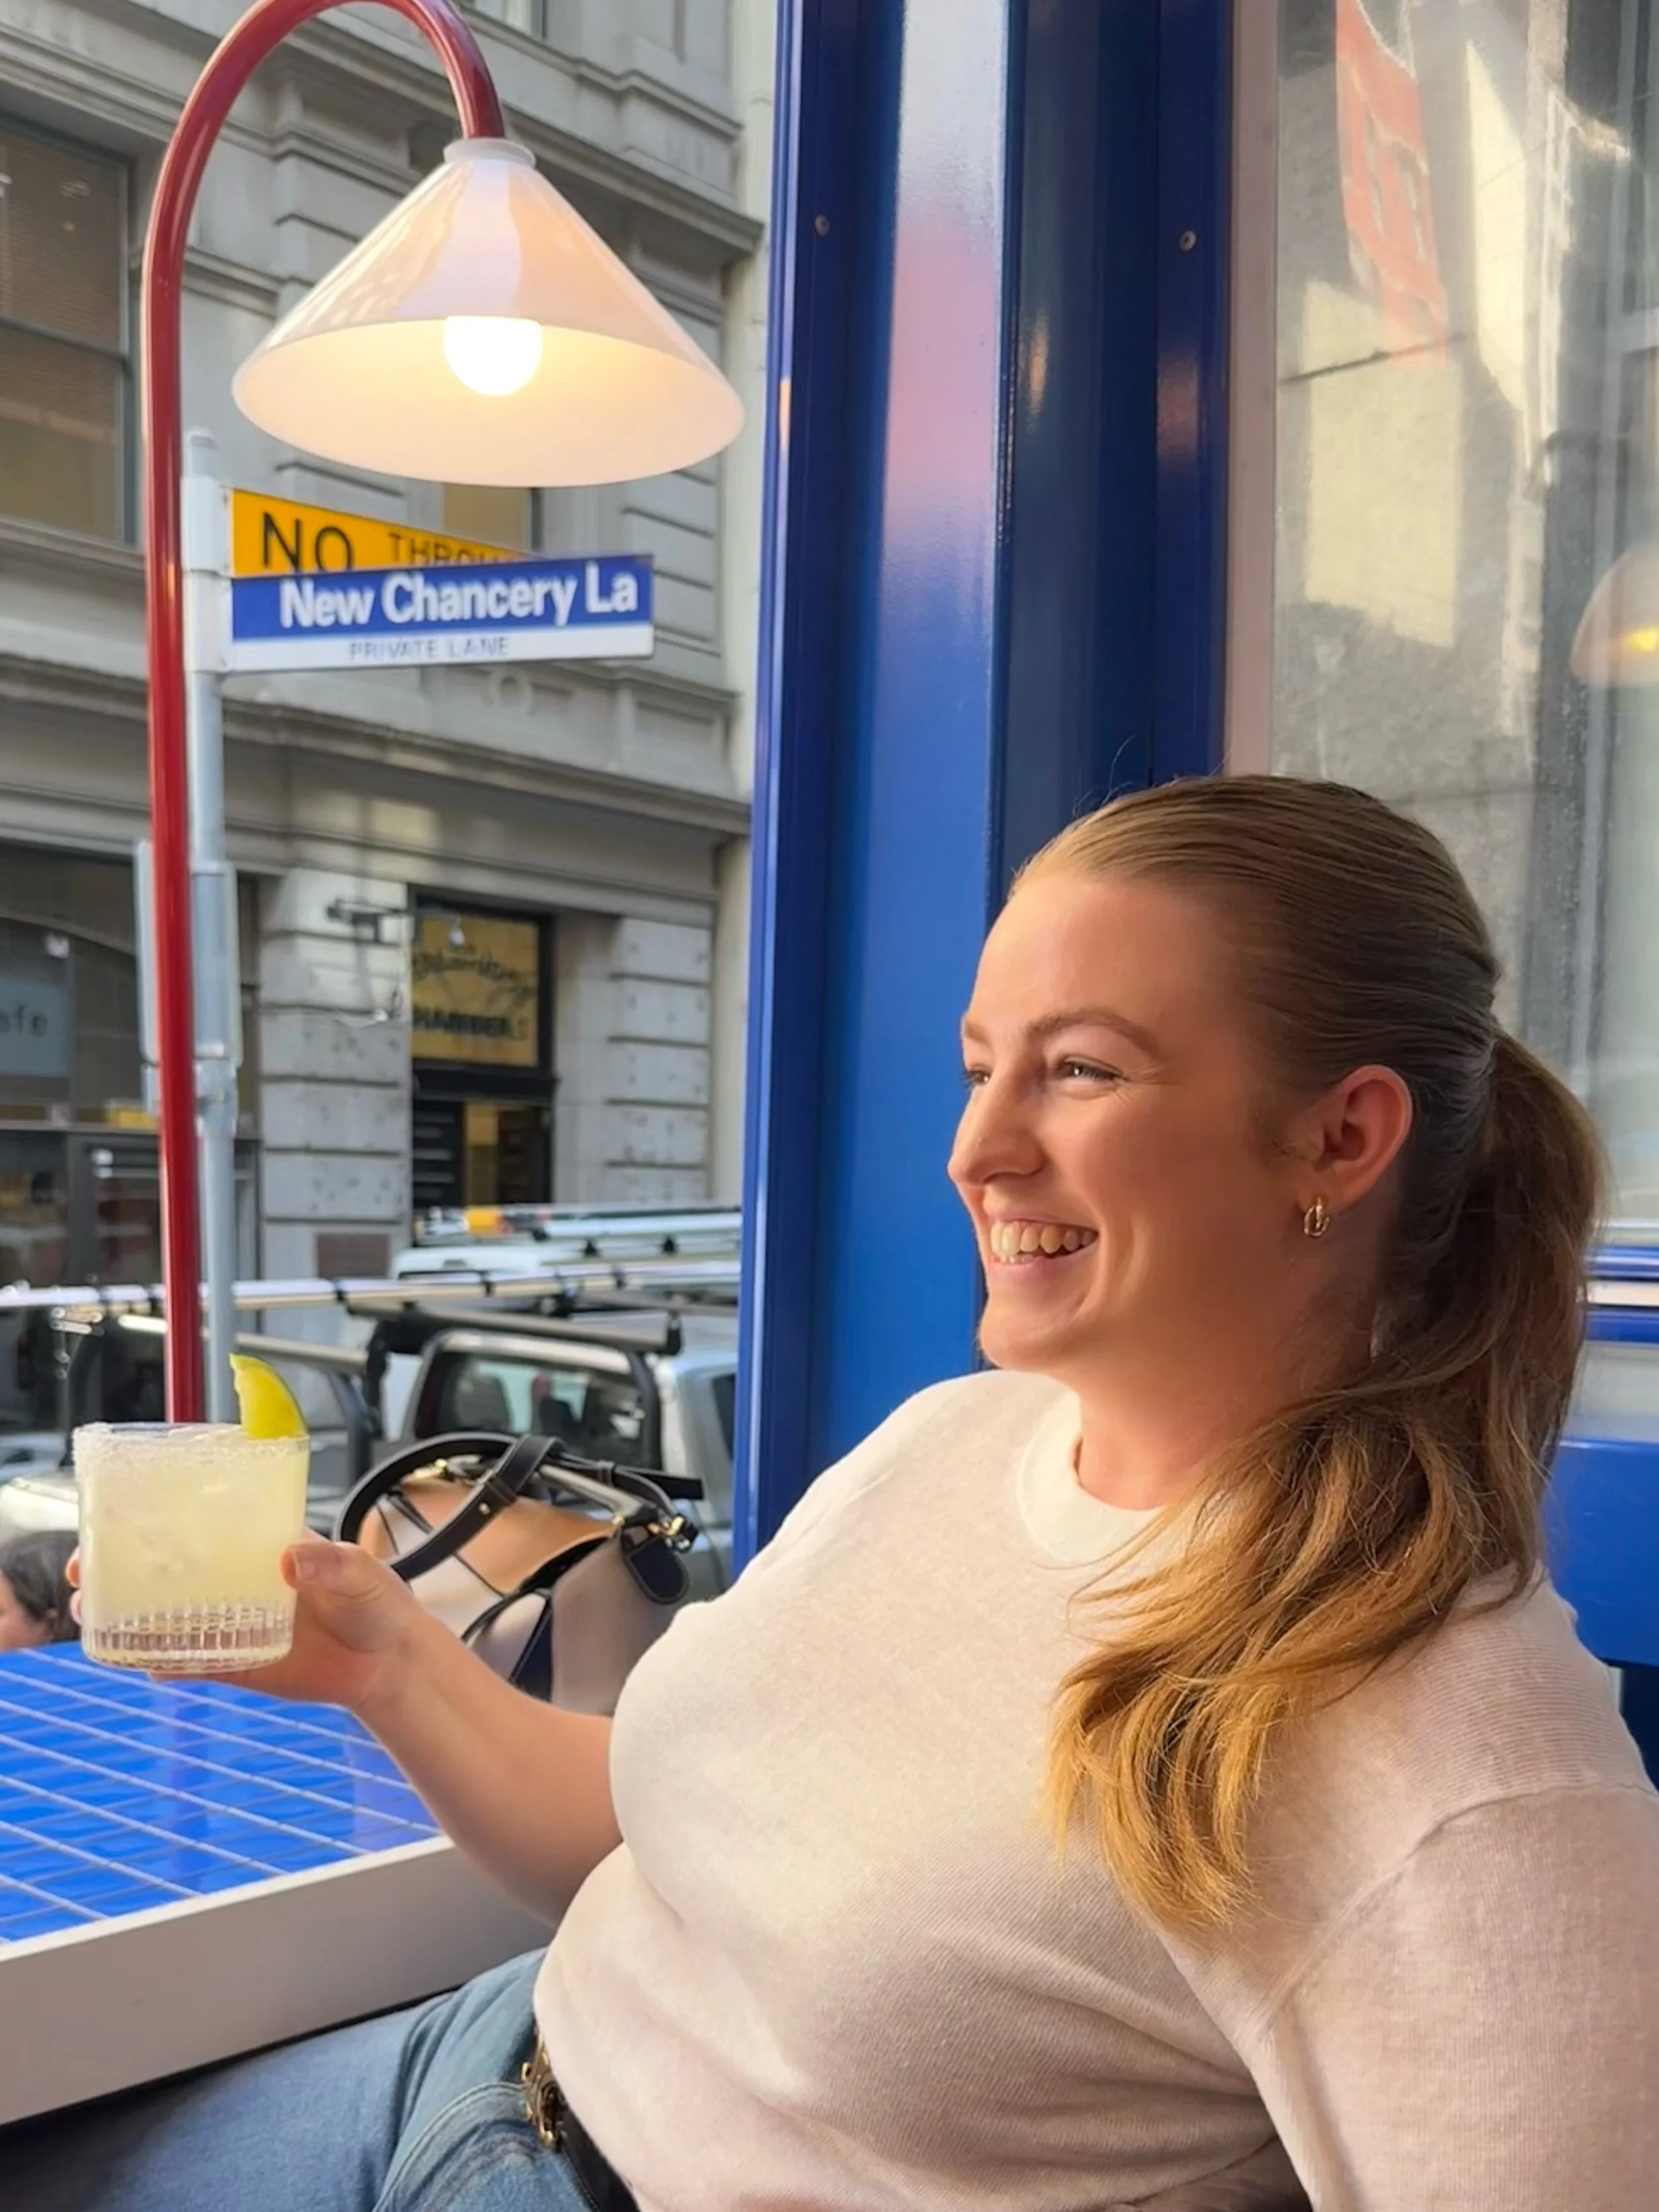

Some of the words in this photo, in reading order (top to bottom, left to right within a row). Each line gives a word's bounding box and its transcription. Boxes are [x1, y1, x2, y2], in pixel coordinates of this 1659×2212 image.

[262, 512, 353, 572] NO
[279, 576, 376, 628] New
[380, 569, 579, 627] Chancery
[585, 559, 638, 613] La
[349, 639, 438, 660] PRIVATE
[449, 636, 510, 658] LANE
